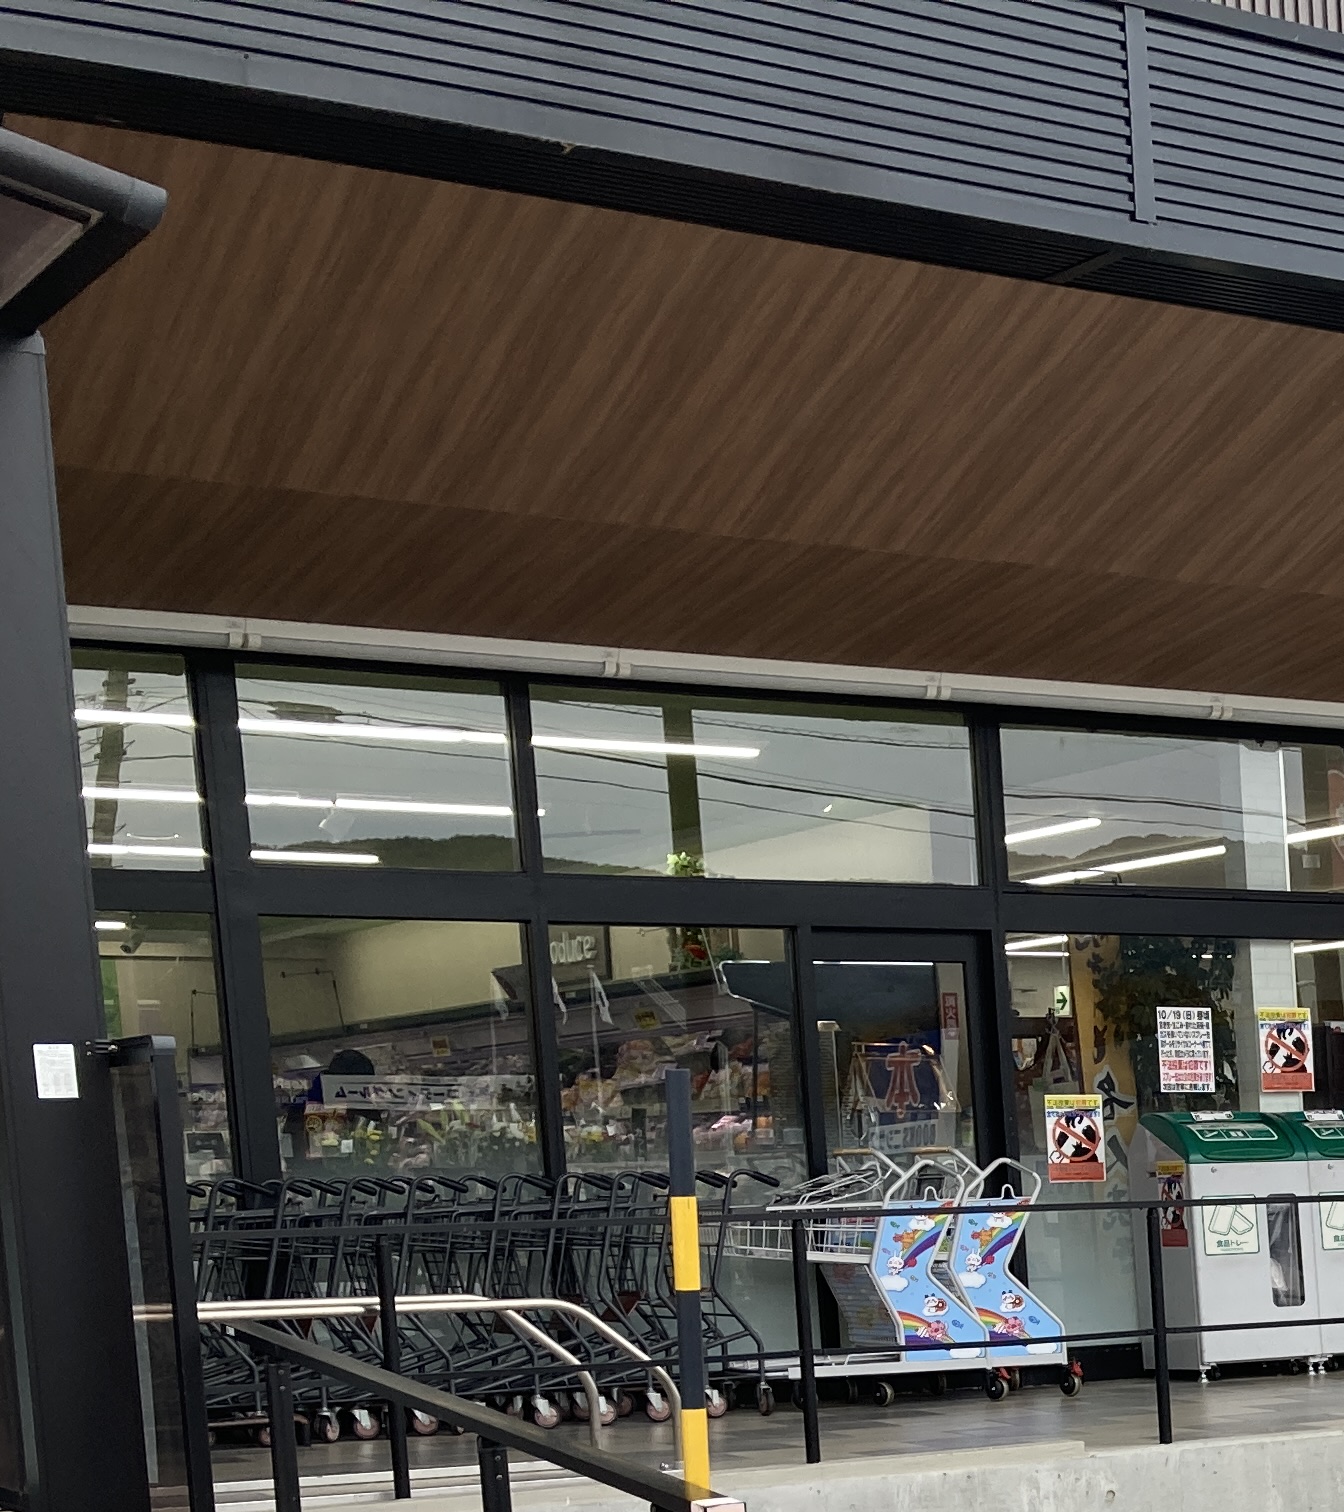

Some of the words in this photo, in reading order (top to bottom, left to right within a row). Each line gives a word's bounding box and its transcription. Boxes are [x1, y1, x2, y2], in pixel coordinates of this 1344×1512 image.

[1216, 1239, 1250, 1248] 食品トレー
